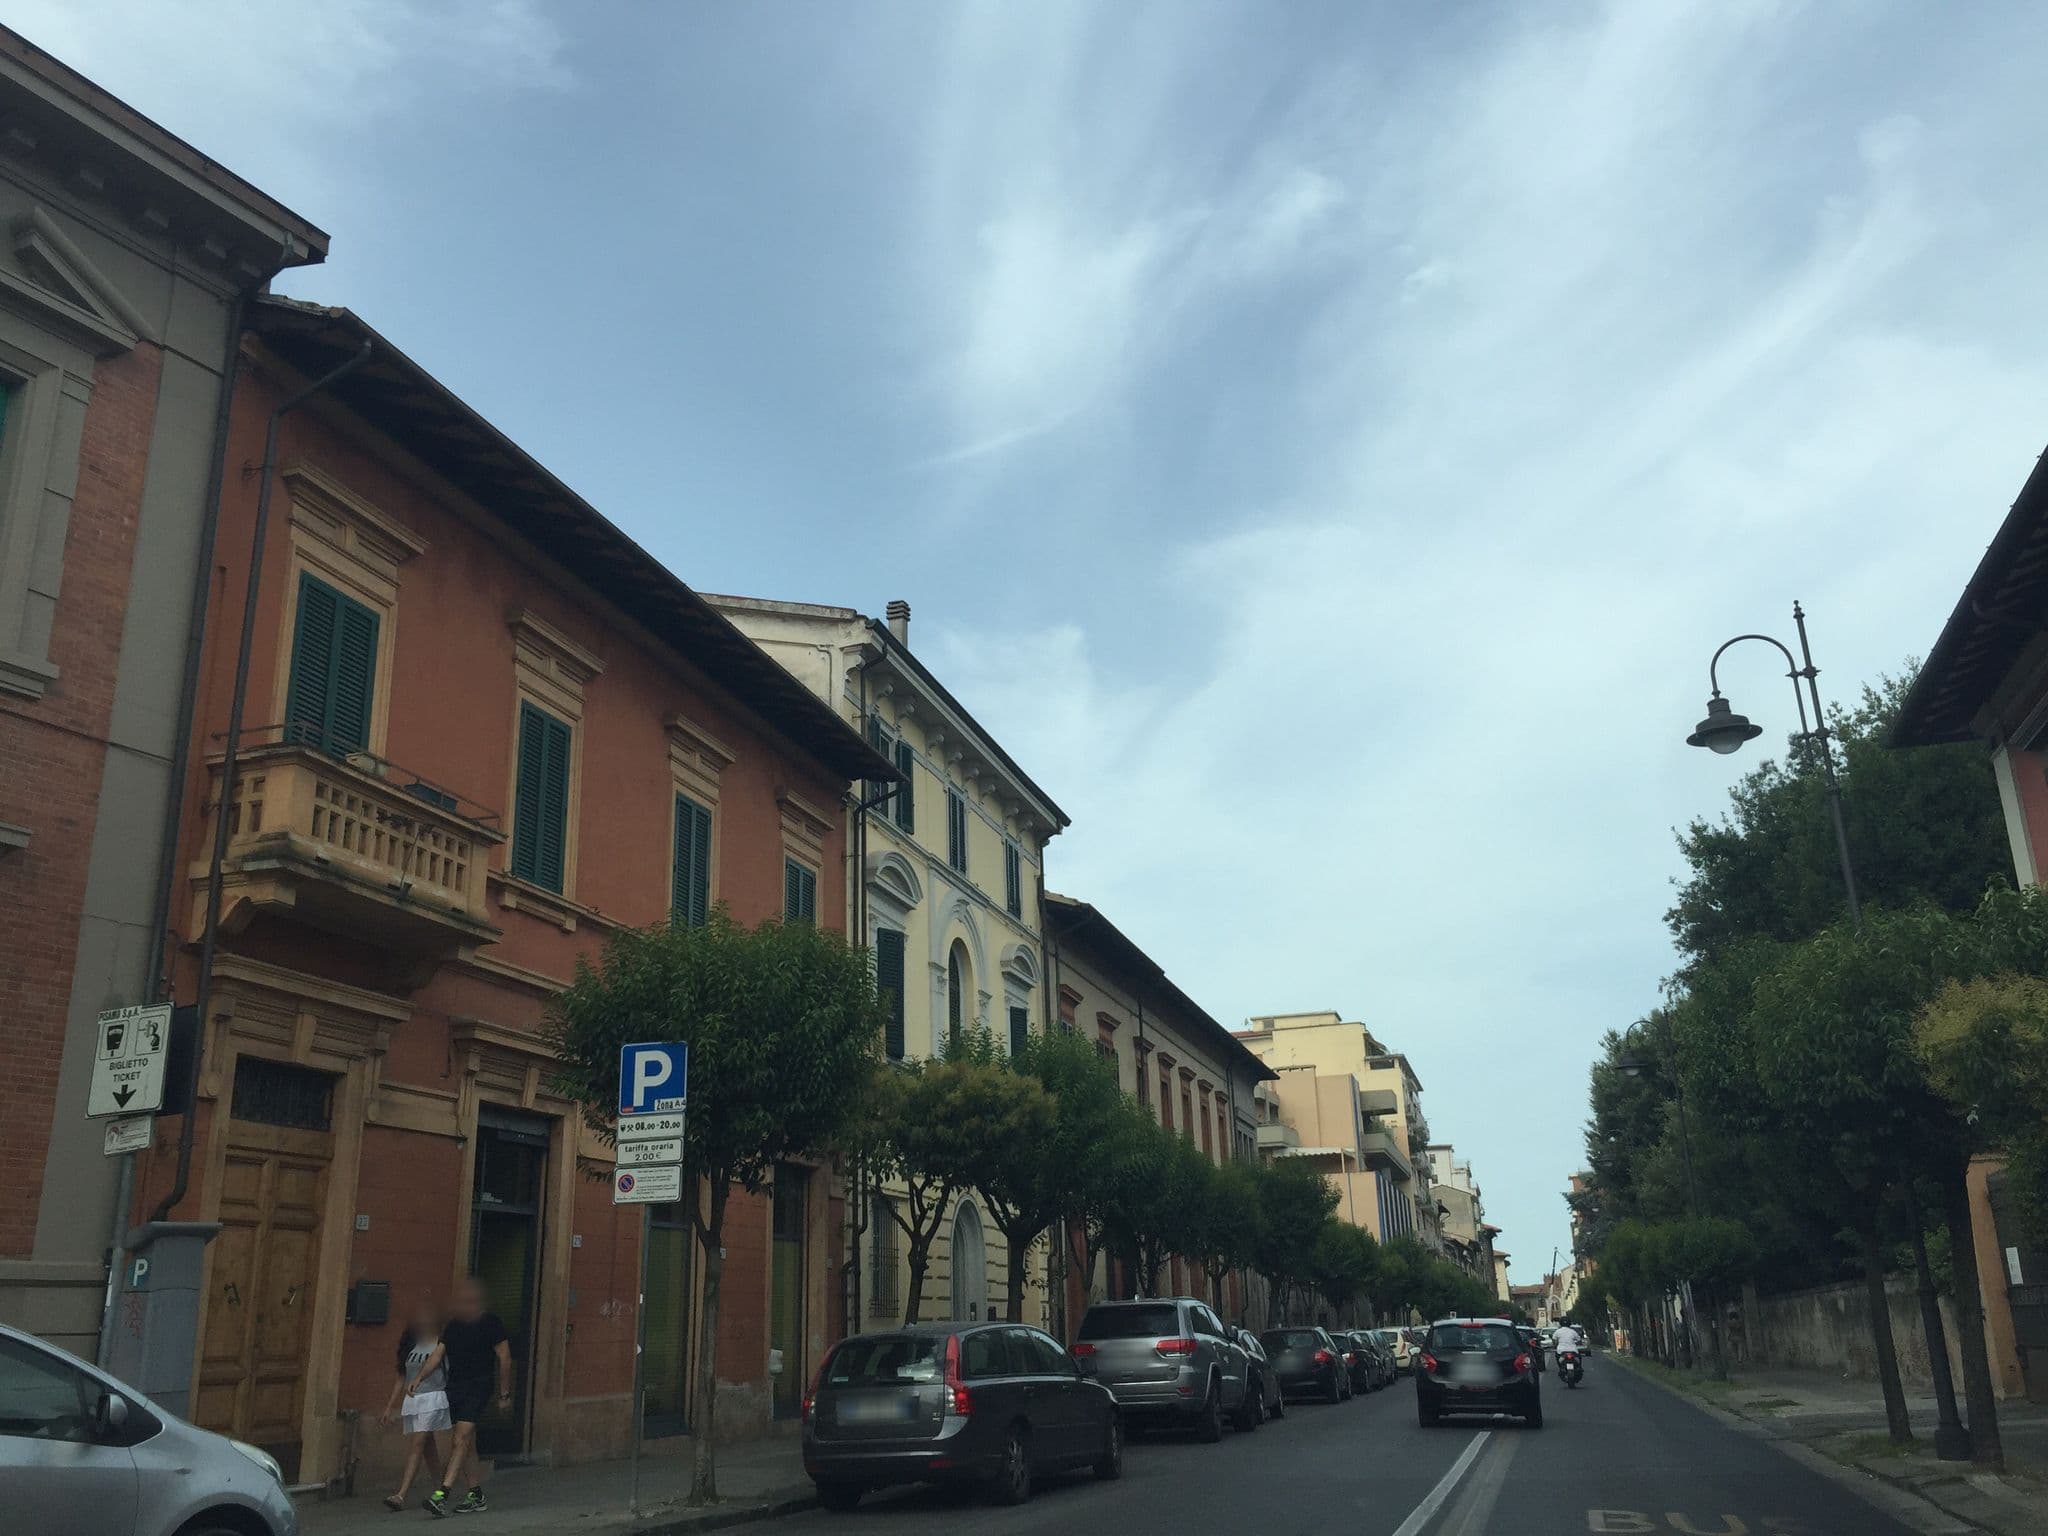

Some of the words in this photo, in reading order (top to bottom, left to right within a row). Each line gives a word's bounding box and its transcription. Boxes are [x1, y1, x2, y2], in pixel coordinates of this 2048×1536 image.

[109, 1058, 149, 1070] BIGLIETTO
[113, 1071, 141, 1082] TICKET
[633, 1050, 672, 1107] P
[625, 1144, 648, 1153] tariffa
[651, 1143, 674, 1151] oraria
[133, 1258, 148, 1286] P
